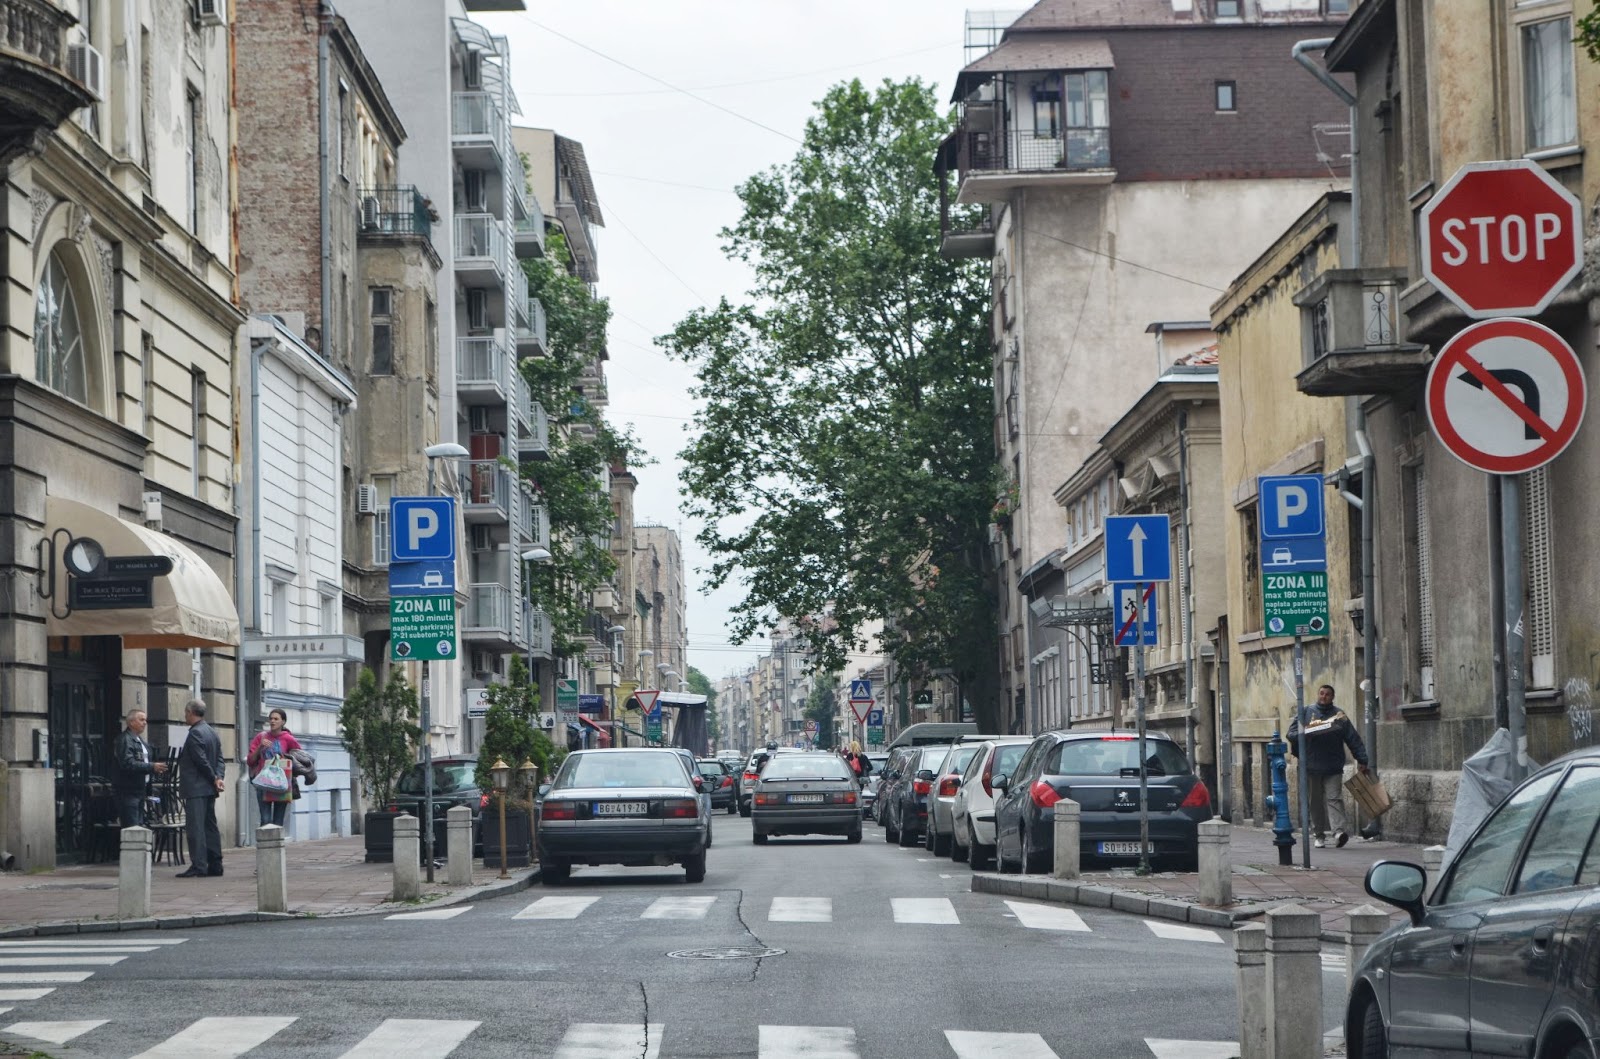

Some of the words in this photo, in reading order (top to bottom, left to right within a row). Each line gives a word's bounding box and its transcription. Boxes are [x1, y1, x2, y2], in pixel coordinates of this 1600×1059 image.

[1441, 212, 1562, 267] STOP
[1276, 485, 1308, 528] P
[408, 508, 439, 550] P
[1267, 576, 1307, 589] ZONA
[1311, 575, 1324, 588] III
[1284, 591, 1297, 599] 180
[1299, 590, 1327, 598] minuta
[394, 599, 434, 613] ZONA
[438, 598, 451, 612] III
[1265, 601, 1291, 609] naplata
[1292, 600, 1327, 608] parkiranja
[411, 614, 425, 623] 180
[392, 624, 418, 632] naplata
[420, 623, 454, 632] parkiranja
[409, 631, 438, 639] subotom
[439, 630, 454, 638] 7-14
[870, 712, 880, 725] P
